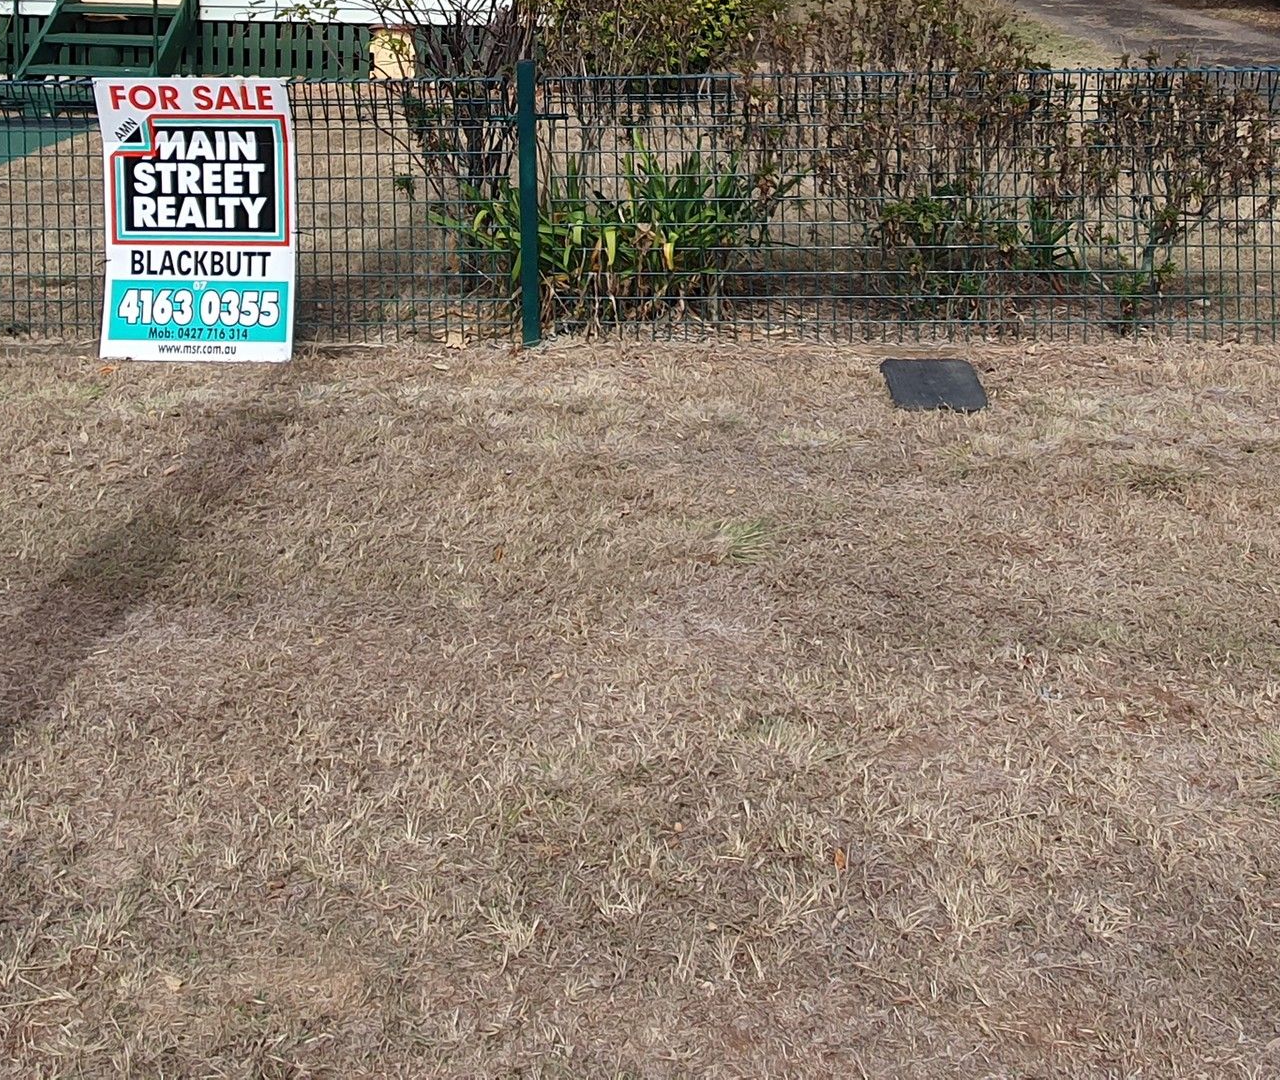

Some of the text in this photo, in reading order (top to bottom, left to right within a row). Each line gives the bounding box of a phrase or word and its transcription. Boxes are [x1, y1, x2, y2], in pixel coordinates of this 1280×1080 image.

[109, 85, 273, 110] FOR SALE
[114, 117, 138, 141] AMN
[143, 130, 257, 161] MAIN
[133, 162, 266, 195] STREET
[133, 196, 267, 229] REALTY
[131, 250, 271, 277] BLACKBUTT
[192, 281, 207, 290] 07
[118, 288, 279, 327] 4163 0355
[148, 327, 248, 340] Mob: 0427 716 314
[158, 344, 237, 355] www.msr.com.au
